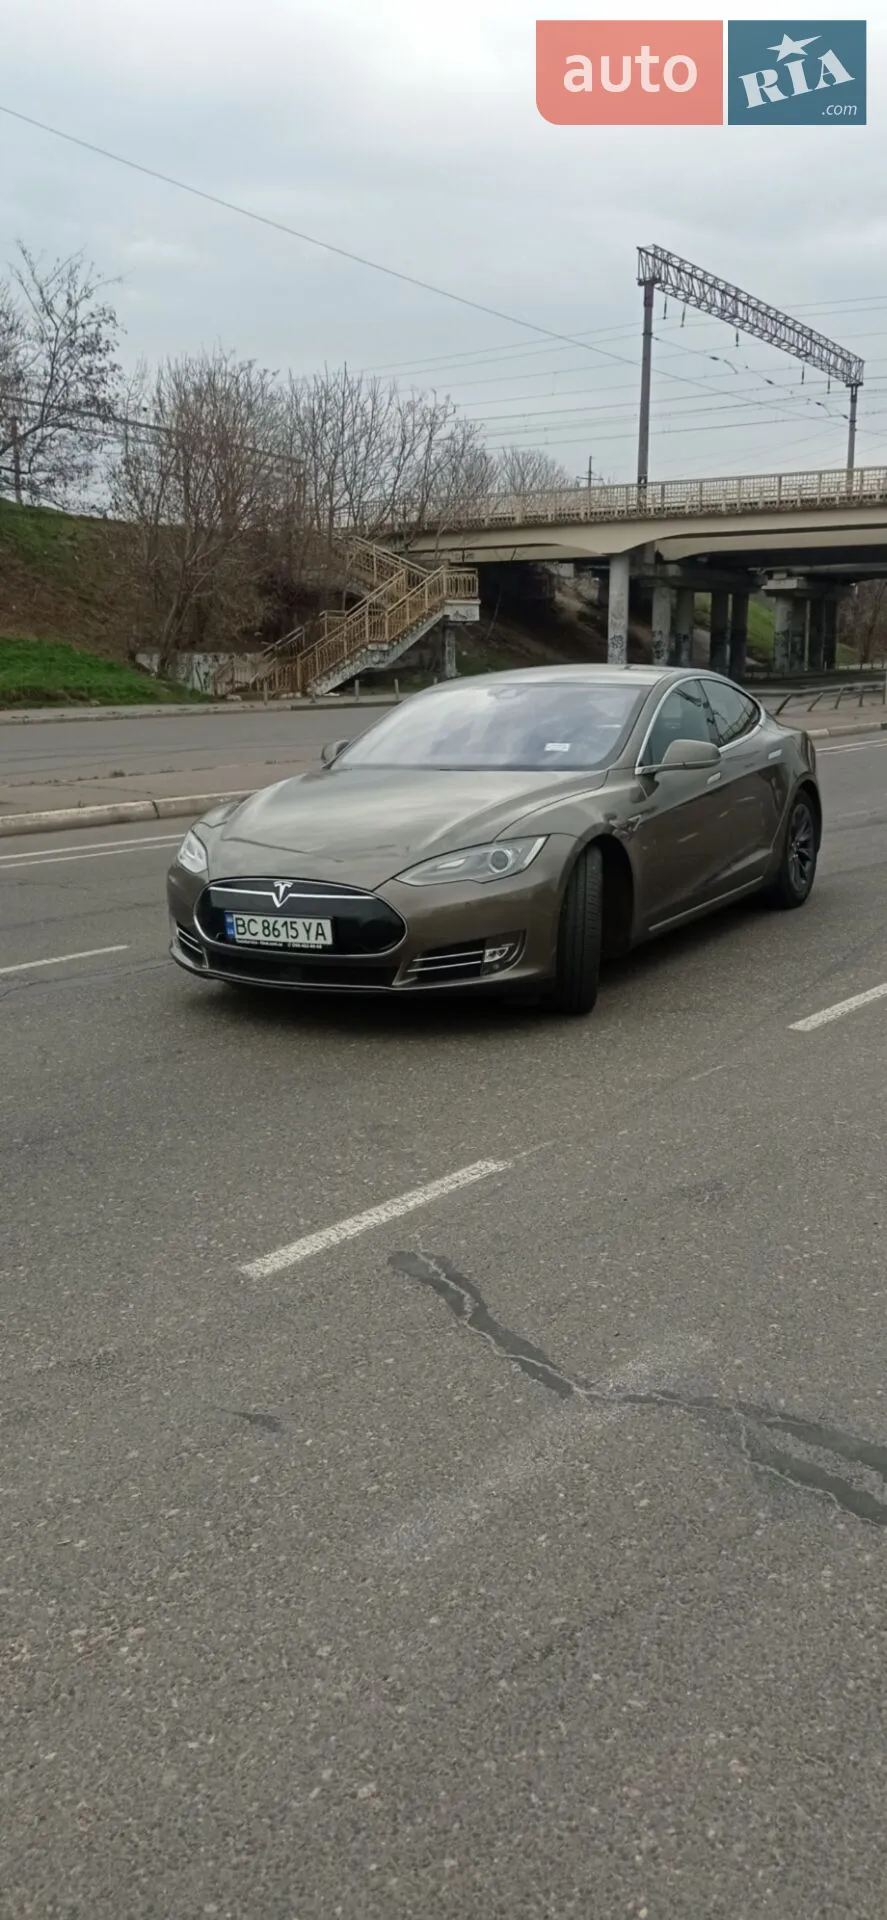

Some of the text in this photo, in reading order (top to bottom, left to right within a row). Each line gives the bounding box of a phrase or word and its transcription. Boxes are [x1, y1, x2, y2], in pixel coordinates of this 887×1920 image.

[235, 917, 327, 941] BC 8615 YA
